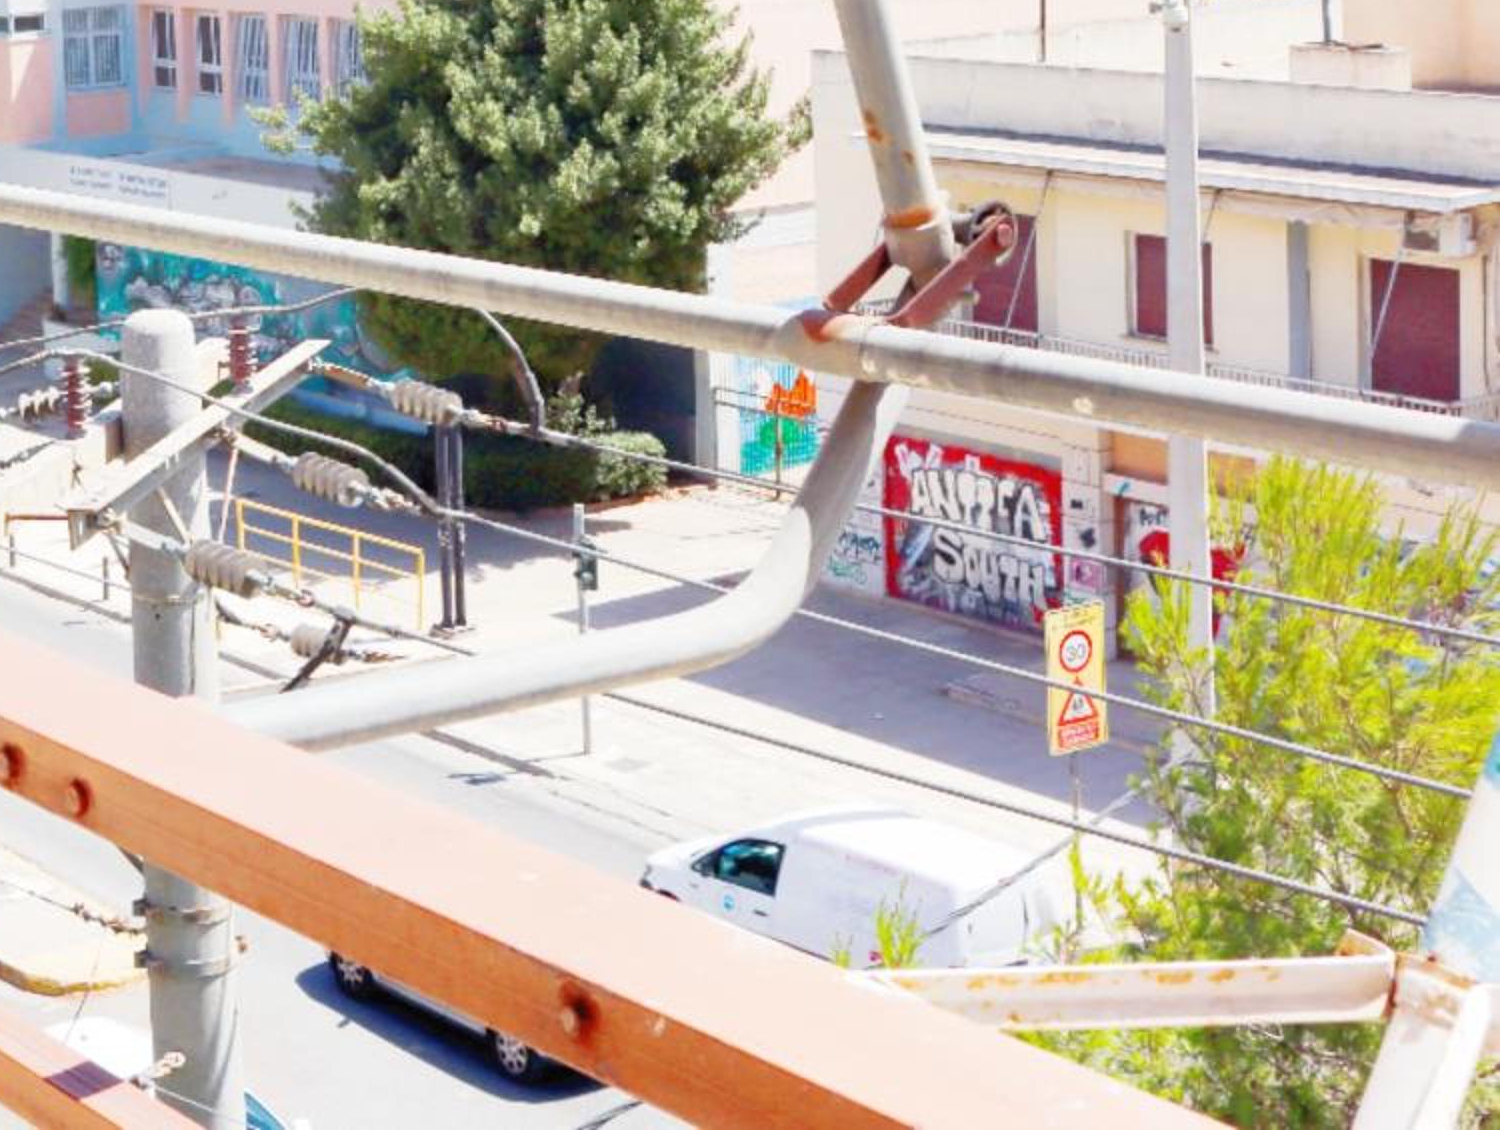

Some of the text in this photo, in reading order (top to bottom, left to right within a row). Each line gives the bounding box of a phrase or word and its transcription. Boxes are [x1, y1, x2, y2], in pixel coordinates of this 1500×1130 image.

[910, 467, 1048, 544] ANTIFA
[931, 527, 1048, 611] SOUTH
[1065, 642, 1087, 662] 30
